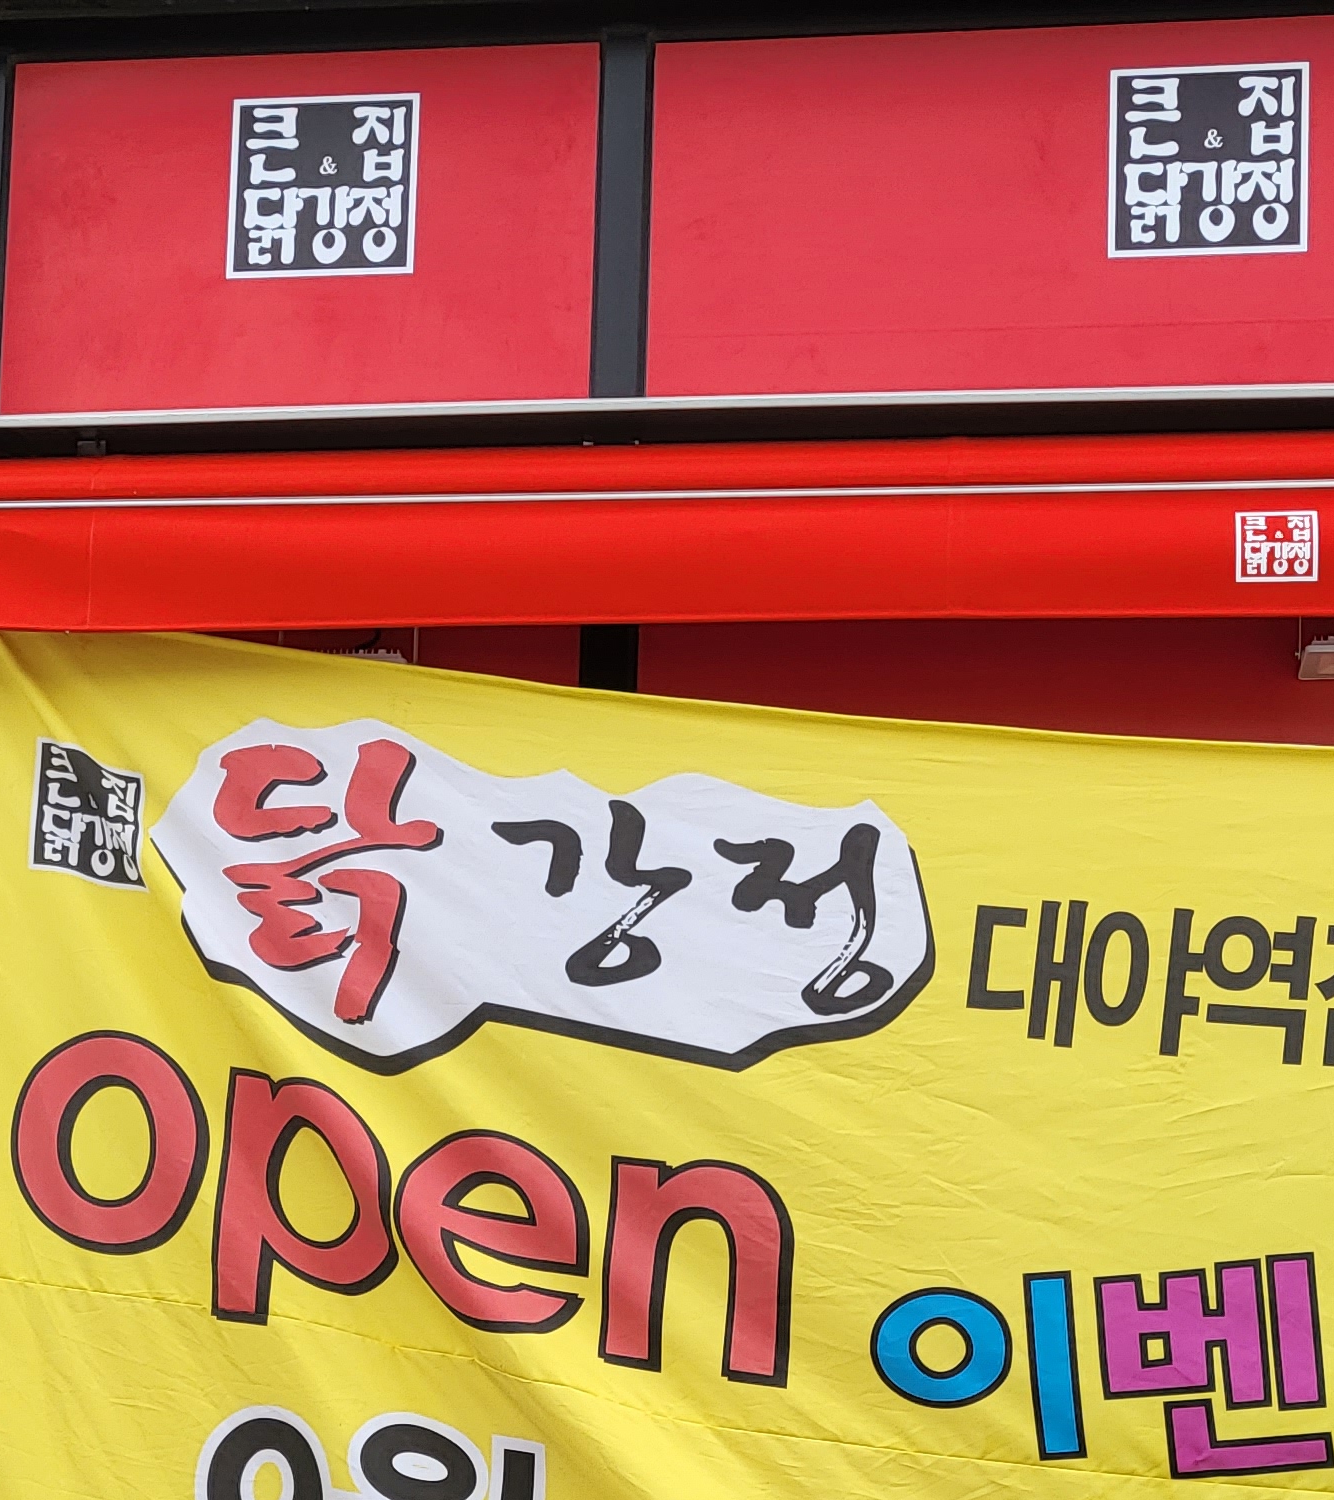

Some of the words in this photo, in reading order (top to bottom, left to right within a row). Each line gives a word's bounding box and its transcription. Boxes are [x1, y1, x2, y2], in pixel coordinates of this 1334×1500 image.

[242, 186, 401, 266] 닭강정
[1123, 160, 1295, 244] 닭강정
[212, 737, 895, 1025] 닭강정
[11, 1029, 794, 1388] open
